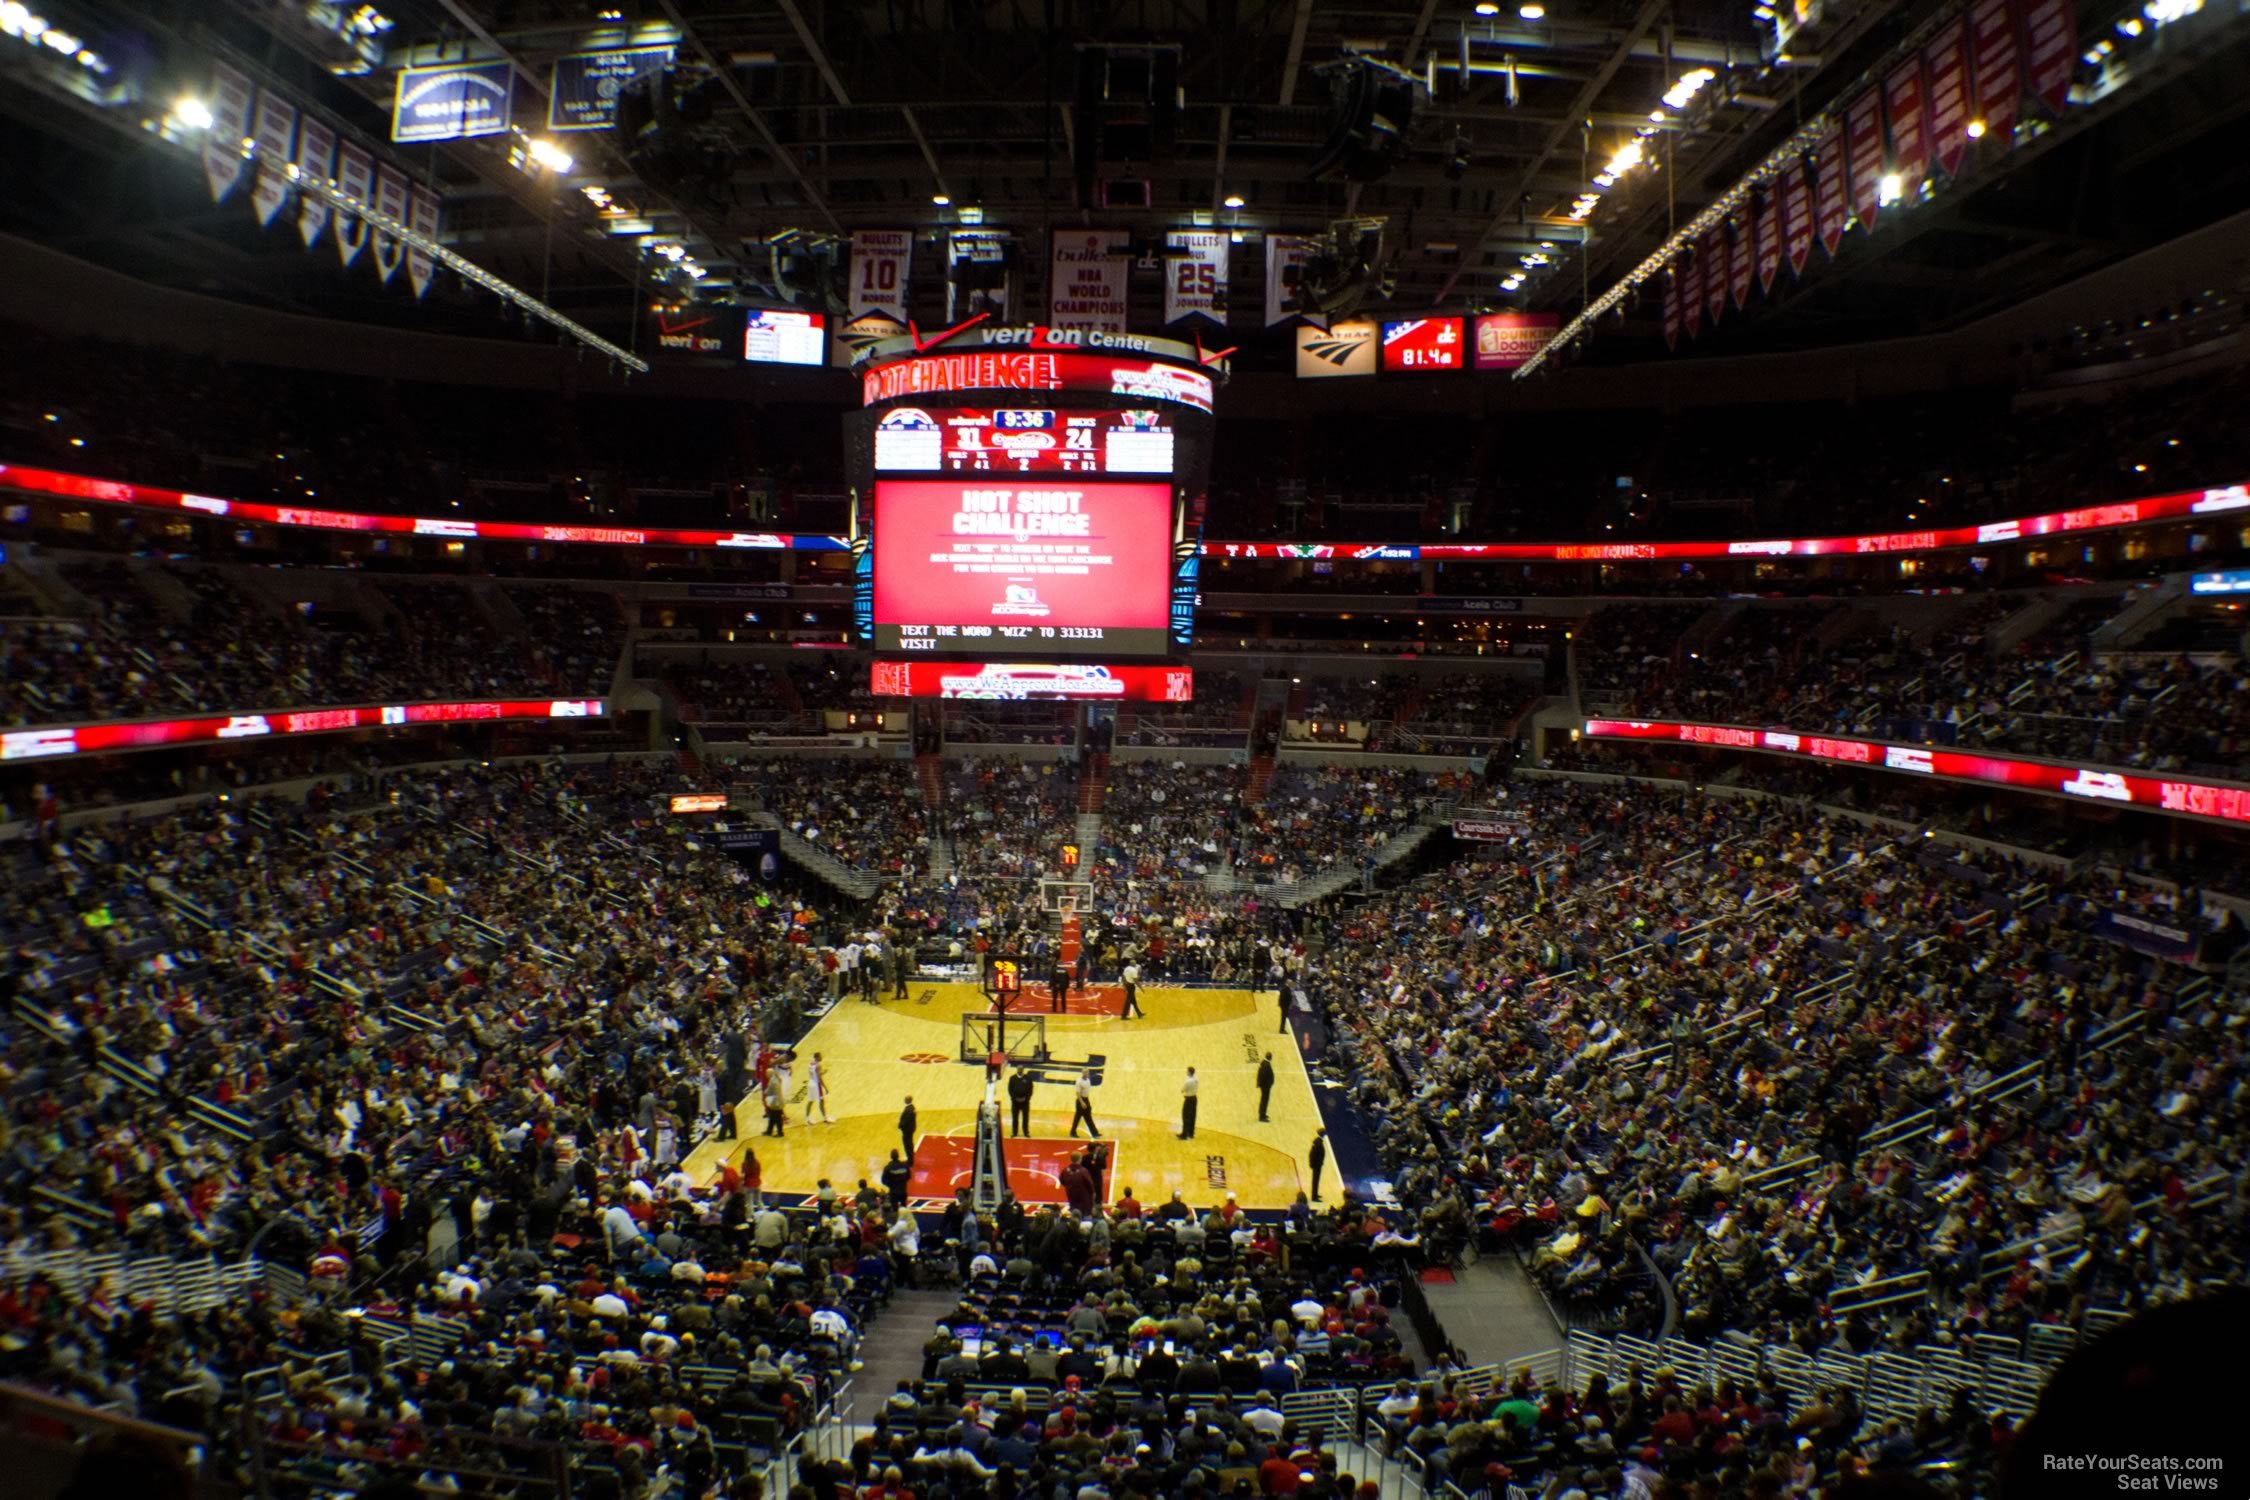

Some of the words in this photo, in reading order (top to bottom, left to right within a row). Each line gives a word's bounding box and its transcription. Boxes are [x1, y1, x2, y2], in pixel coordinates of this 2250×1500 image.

[1176, 235, 1220, 247] BULLETS
[863, 259, 897, 290] 10
[1077, 268, 1103, 283] NBA
[1178, 263, 1216, 294] 25
[1068, 285, 1111, 298] WORLD
[1054, 300, 1124, 315] CHAMPIONS
[1176, 298, 1213, 307] JOHNSO
[659, 333, 722, 353] verizon
[982, 323, 1079, 349] verizon
[1088, 330, 1153, 351] Center
[1003, 410, 1045, 427] 9:36
[1065, 428, 1093, 449] 24
[962, 489, 1012, 513] HOT
[1017, 491, 1083, 514] SHOT
[952, 512, 1090, 536] CHALLENGE
[900, 625, 930, 636] TEXT
[934, 625, 957, 637] THE
[961, 626, 992, 637] WORD
[997, 626, 1033, 637] "WIZ"
[1039, 626, 1055, 638] TO
[1060, 627, 1104, 639] 313131
[900, 638, 937, 649] VISIT
[998, 972, 1014, 989] 17
